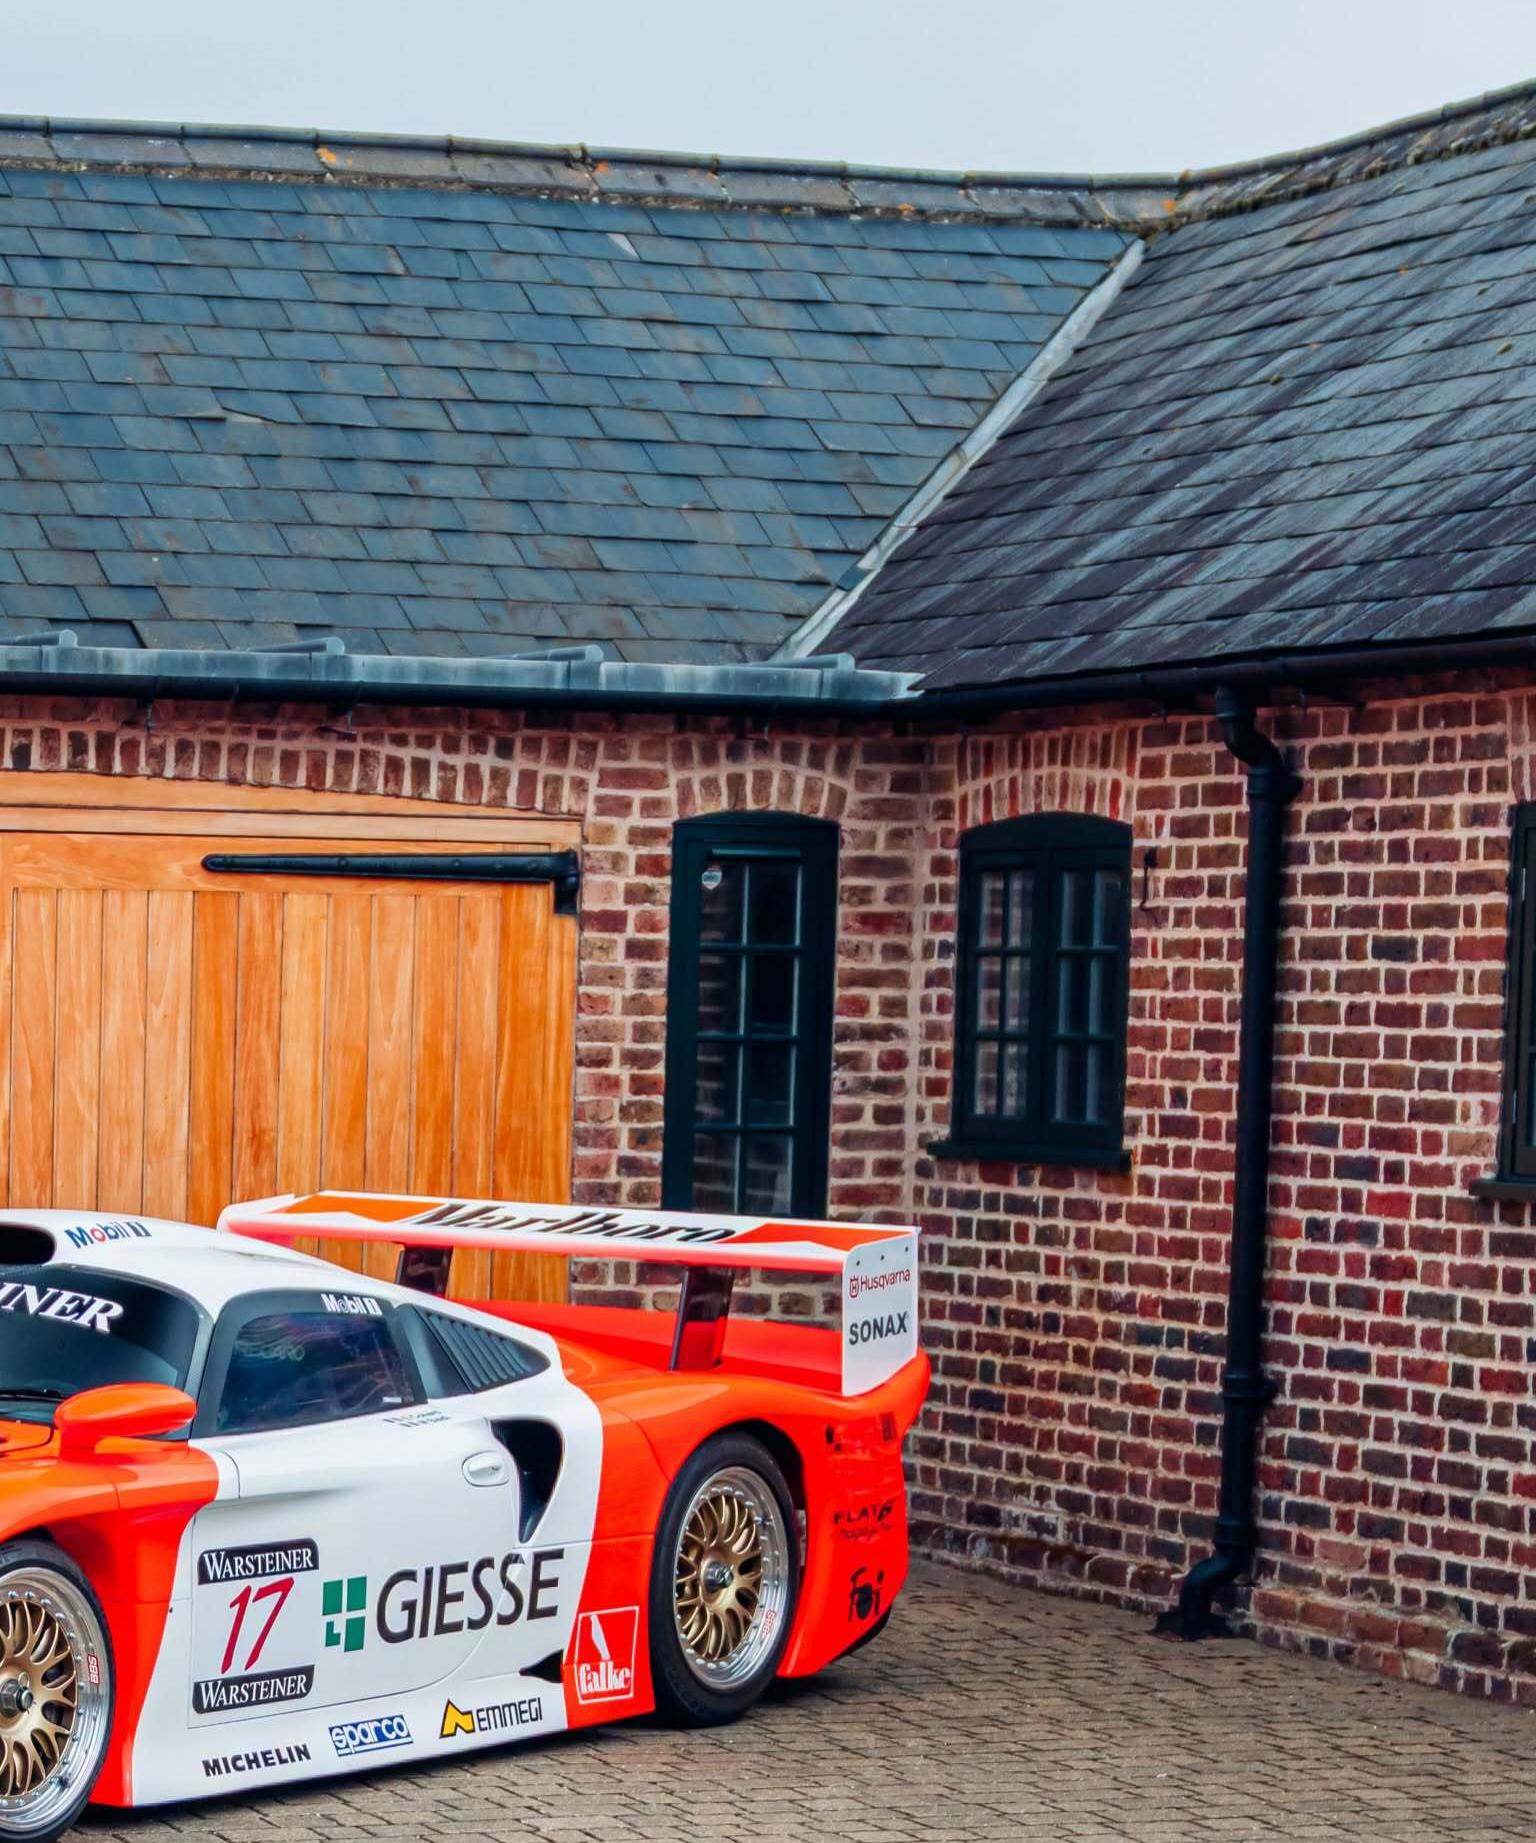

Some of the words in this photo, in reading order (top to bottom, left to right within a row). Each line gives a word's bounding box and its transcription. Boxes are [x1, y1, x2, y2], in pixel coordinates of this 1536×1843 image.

[64, 1221, 131, 1249] Mobil
[415, 1203, 736, 1242] Marlboro
[860, 1269, 911, 1292] Husqvarna
[320, 1293, 368, 1314] Mobil
[849, 1311, 908, 1346] SONAX
[376, 1548, 565, 1644] GIESSE
[220, 1577, 295, 1675] 17
[87, 1655, 100, 1685] BBS
[578, 1661, 632, 1694] falke
[476, 1697, 543, 1732] EMMEGI
[331, 1716, 410, 1753] sparco
[202, 1744, 312, 1777] MICHELIN
